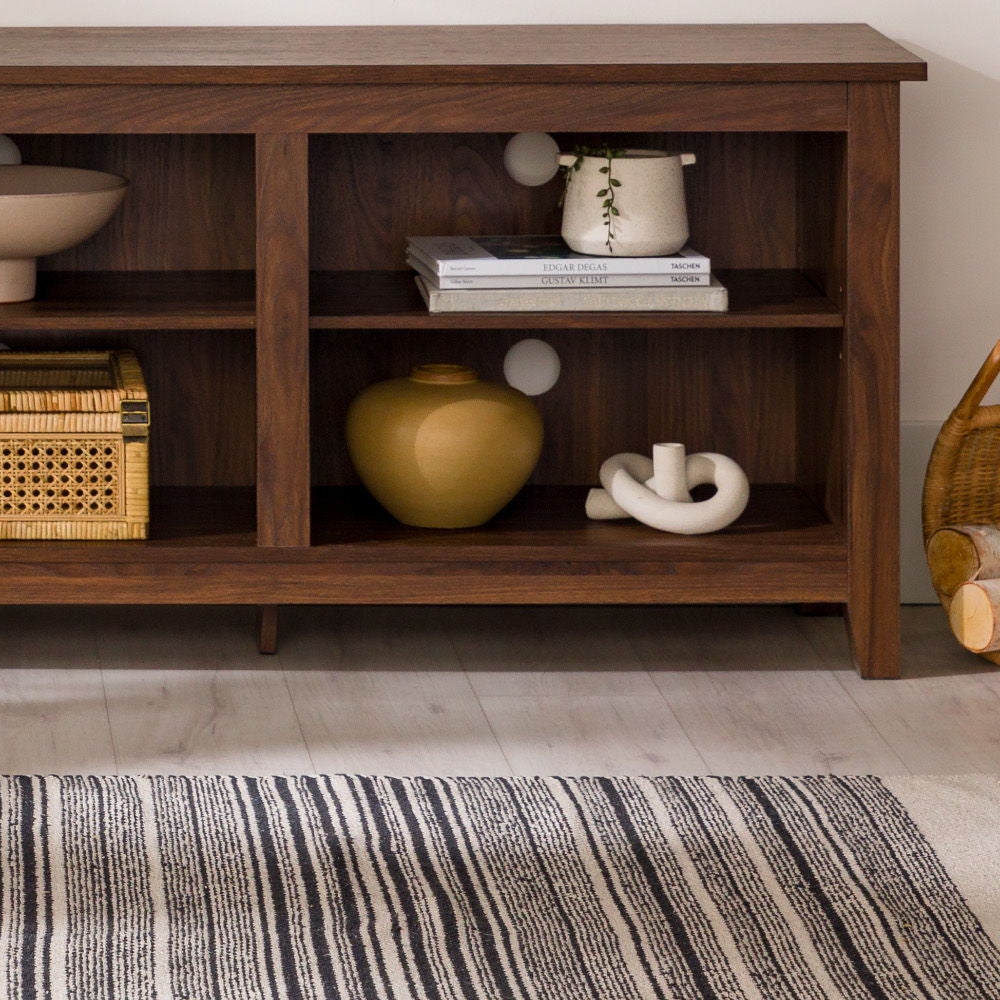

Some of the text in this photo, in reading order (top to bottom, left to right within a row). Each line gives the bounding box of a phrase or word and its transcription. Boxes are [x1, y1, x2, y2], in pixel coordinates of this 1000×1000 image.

[543, 263, 575, 272] EDGAR
[577, 263, 608, 272] DEGAS
[541, 276, 577, 285] GUSTAV
[579, 275, 609, 285] KLIMT
